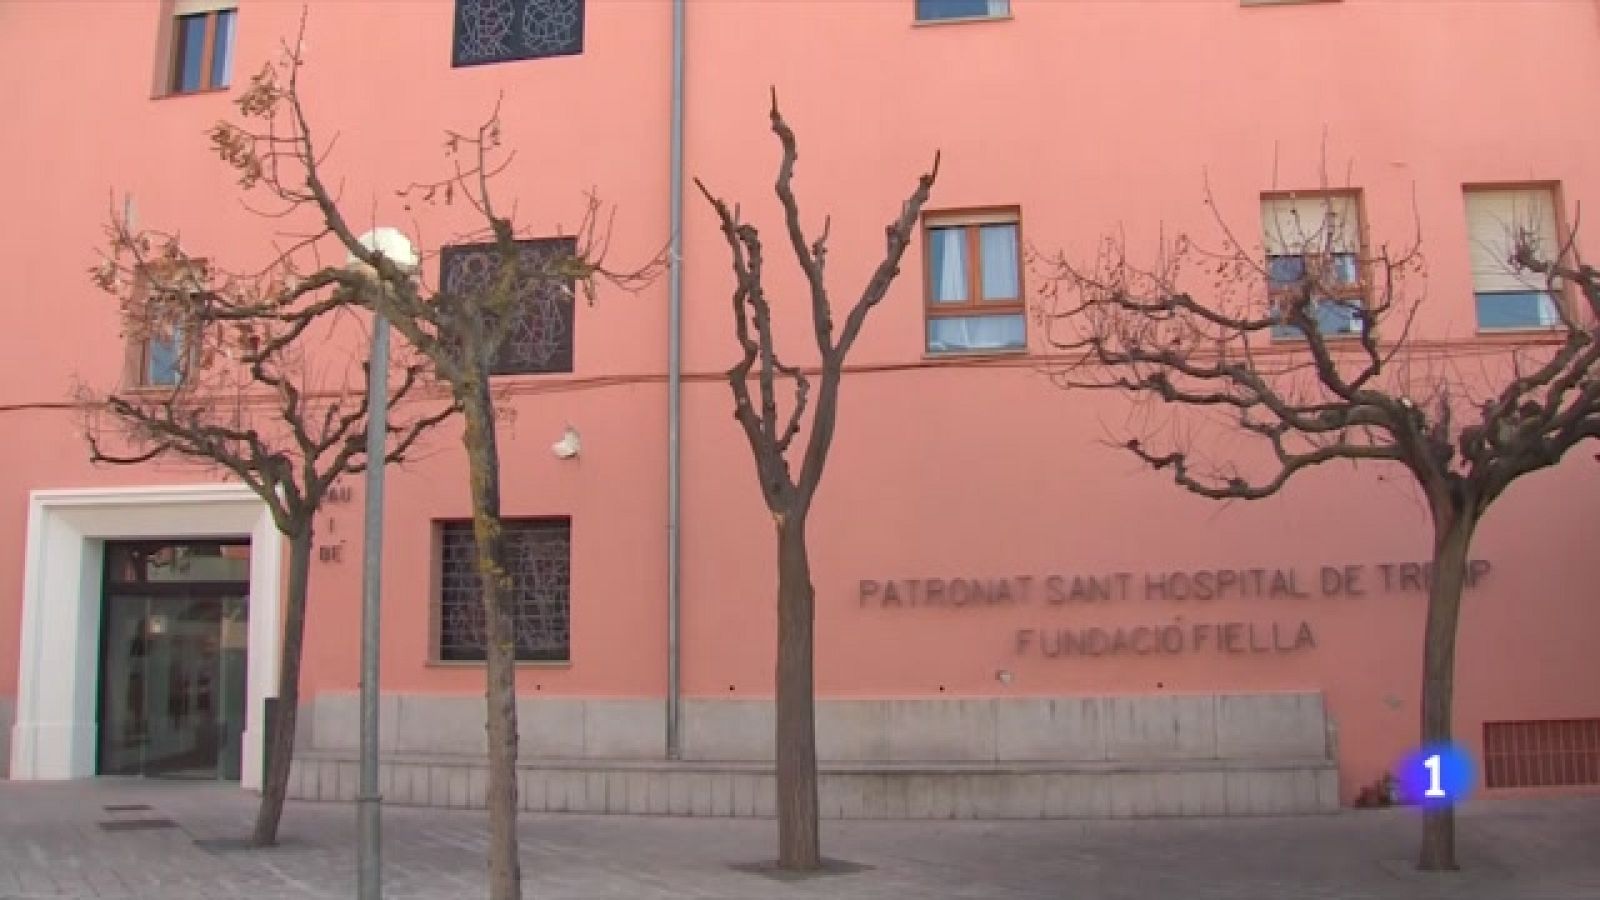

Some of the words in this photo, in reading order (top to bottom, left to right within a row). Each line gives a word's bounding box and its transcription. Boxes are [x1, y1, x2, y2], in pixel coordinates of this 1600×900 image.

[319, 487, 352, 503] AU
[859, 577, 1034, 609] PATRONAT
[1046, 573, 1134, 607] SANT
[1144, 567, 1309, 602] HOSPITAL
[1319, 564, 1366, 596] DE
[1015, 616, 1184, 657] FUNDACIÓ
[1193, 620, 1317, 653] FIELLA
